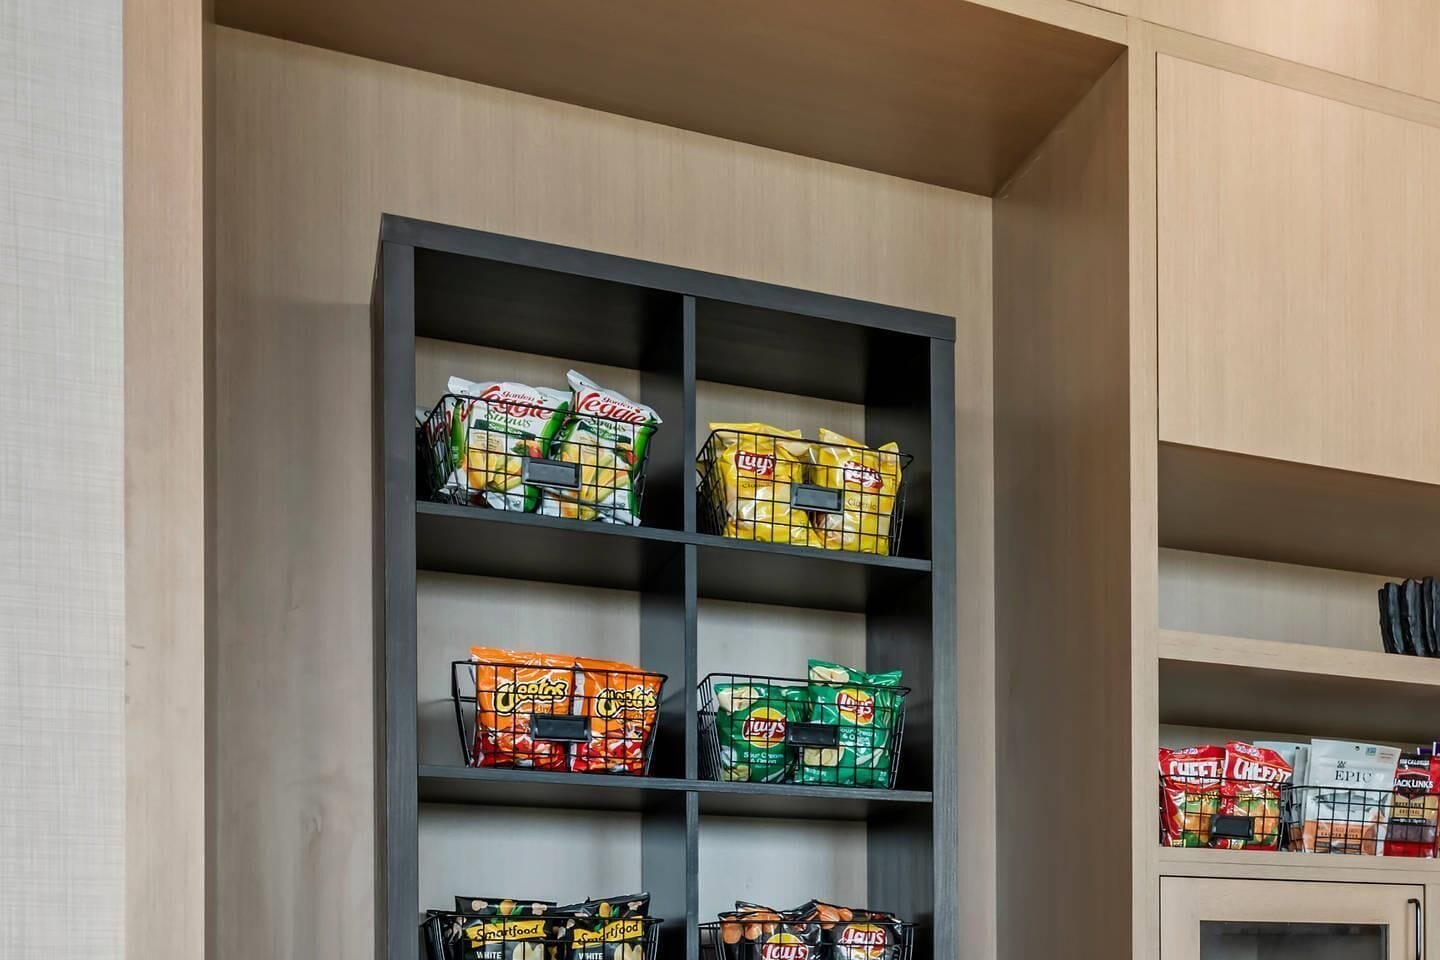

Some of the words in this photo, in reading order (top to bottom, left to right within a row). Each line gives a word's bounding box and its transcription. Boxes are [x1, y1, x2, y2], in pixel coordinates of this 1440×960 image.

[460, 386, 555, 421] Veggie
[574, 392, 647, 424] Veggie
[495, 678, 568, 713] Cheetos
[596, 688, 657, 717] Cheetos
[744, 717, 787, 739] Lay's
[1335, 770, 1373, 783] EPIC
[474, 924, 539, 941] Smartfood
[476, 951, 502, 960] WHITE
[578, 952, 604, 960] WHITE
